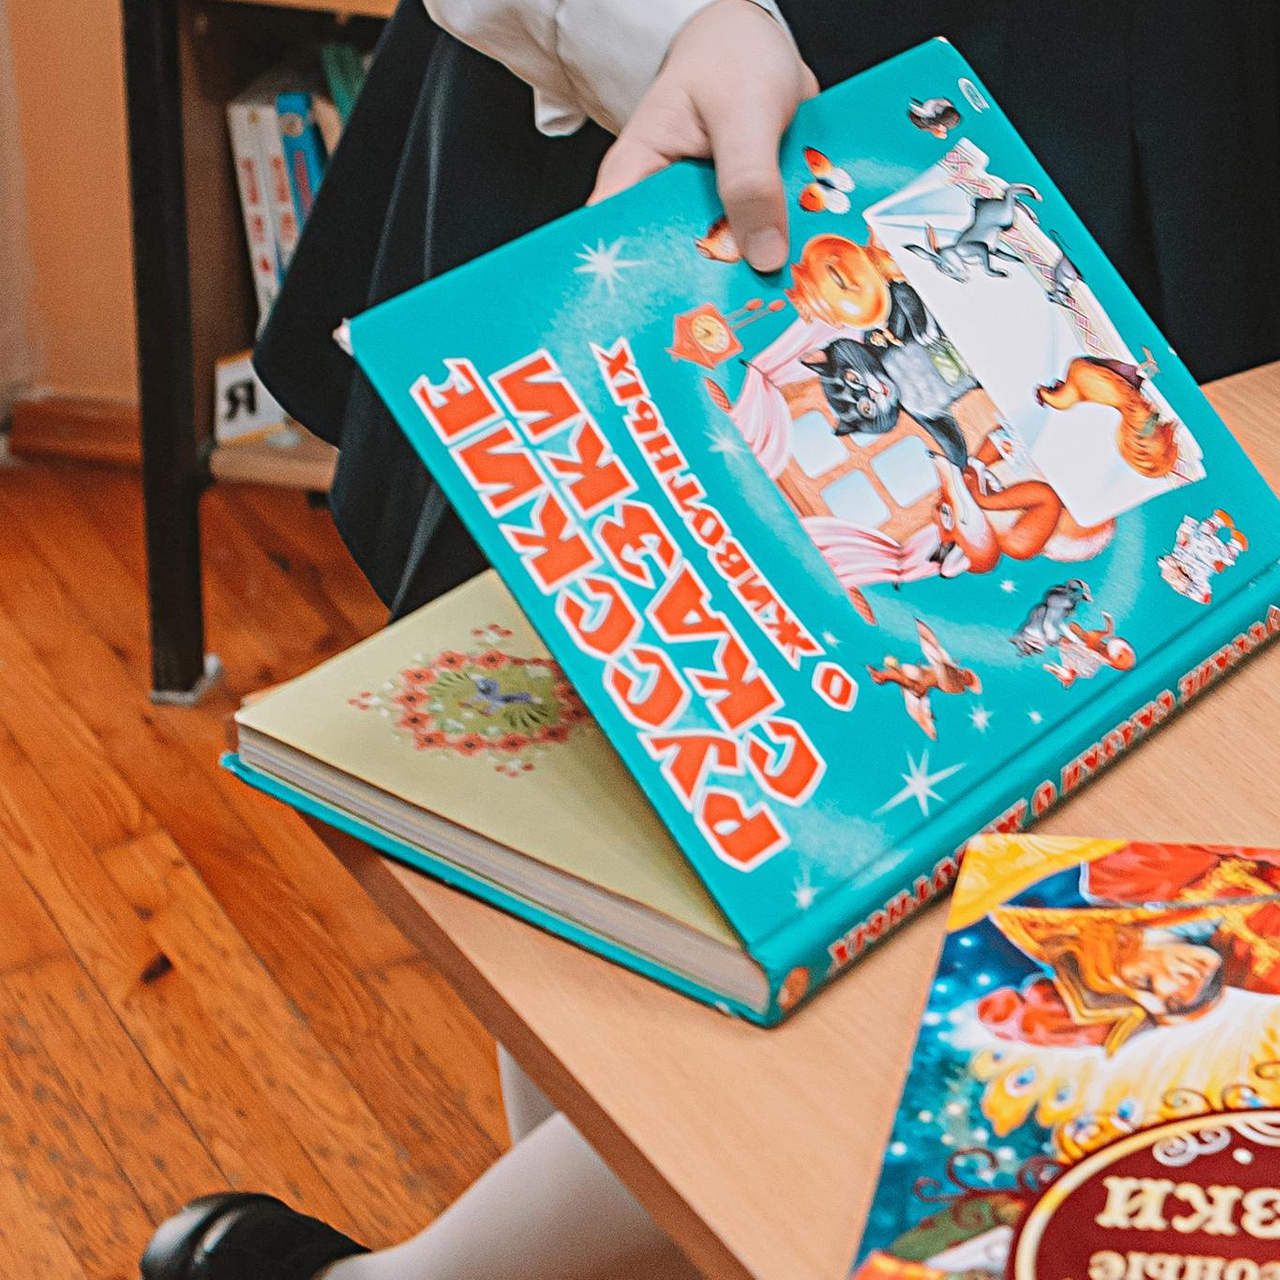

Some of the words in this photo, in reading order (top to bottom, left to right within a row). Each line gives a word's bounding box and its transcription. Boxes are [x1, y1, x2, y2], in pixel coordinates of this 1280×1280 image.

[225, 379, 256, 422] Я
[492, 348, 829, 807] СКАЗКИ
[588, 337, 830, 659] ЖИВОТНЫХ
[410, 359, 789, 872] РУССКИЕ
